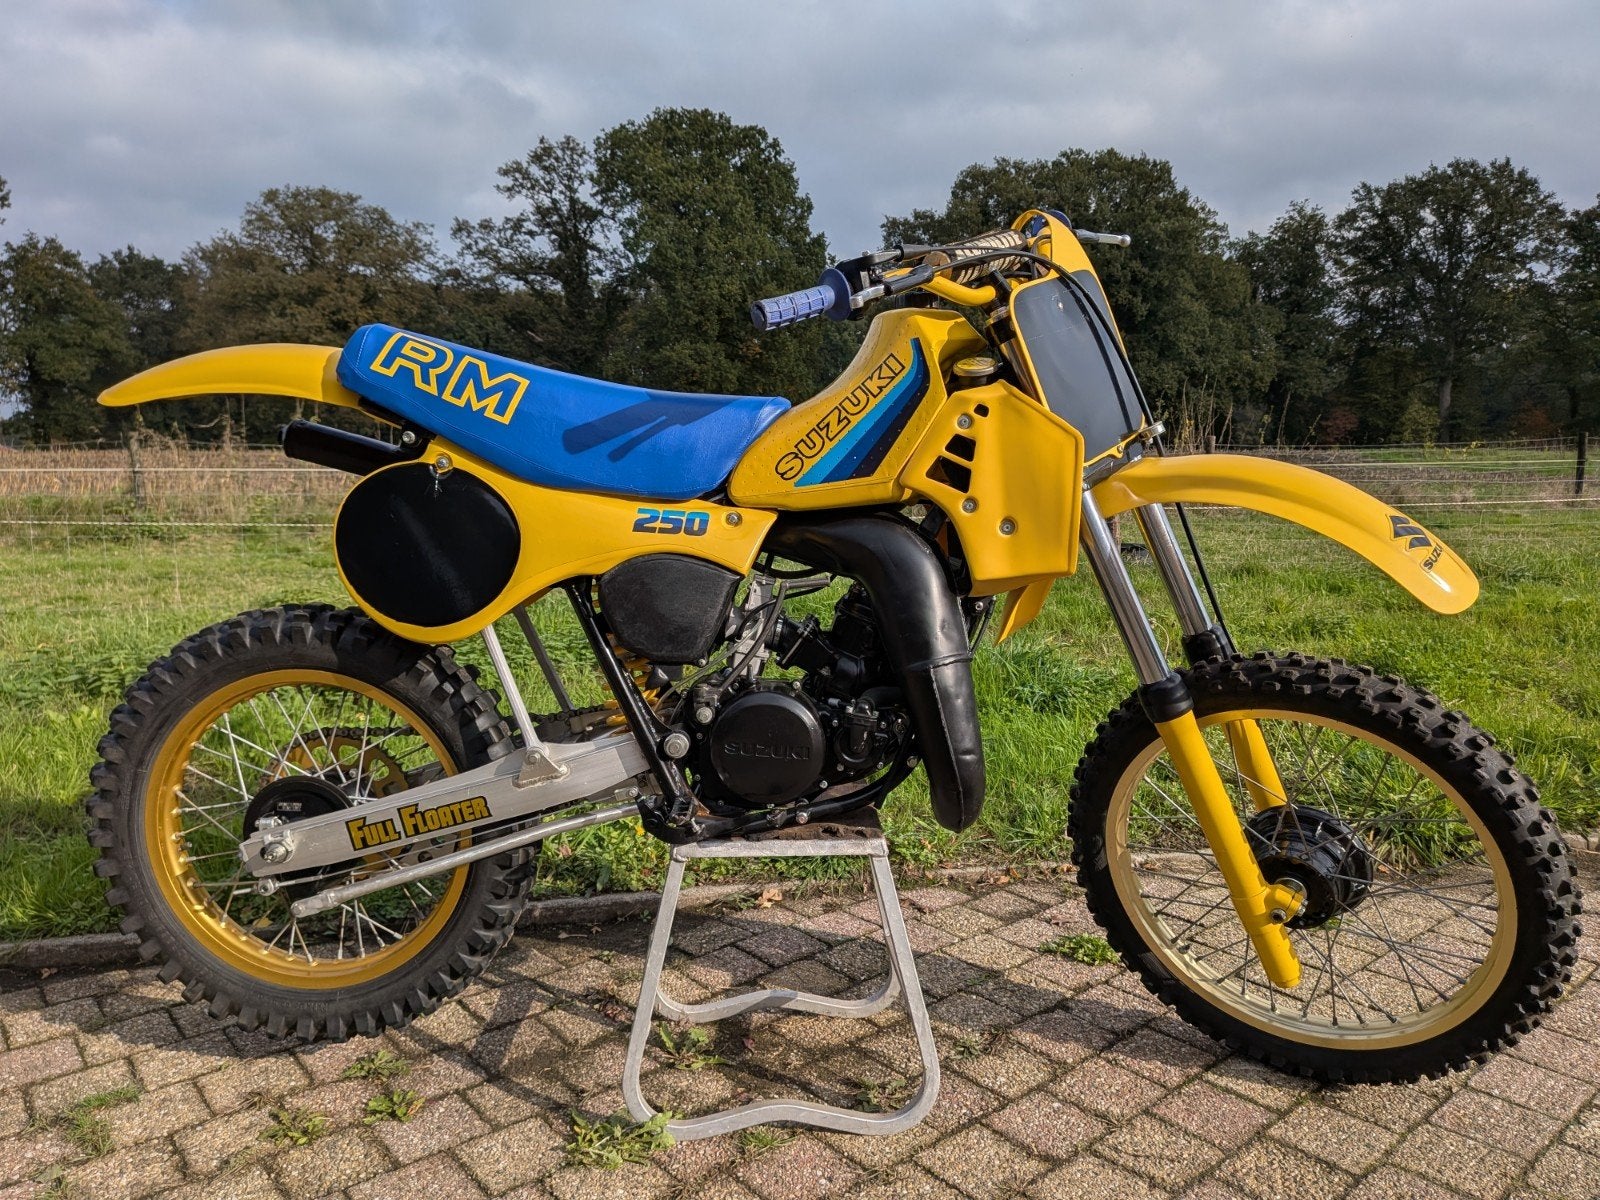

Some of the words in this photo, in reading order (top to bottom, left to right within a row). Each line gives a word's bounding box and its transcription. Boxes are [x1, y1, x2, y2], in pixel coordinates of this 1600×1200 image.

[370, 331, 530, 425] RM
[775, 353, 905, 480] SUZUKI
[632, 508, 710, 536] 250
[724, 743, 809, 760] SUZUKI
[345, 816, 401, 850] FULL
[397, 796, 492, 837] FLOATER
